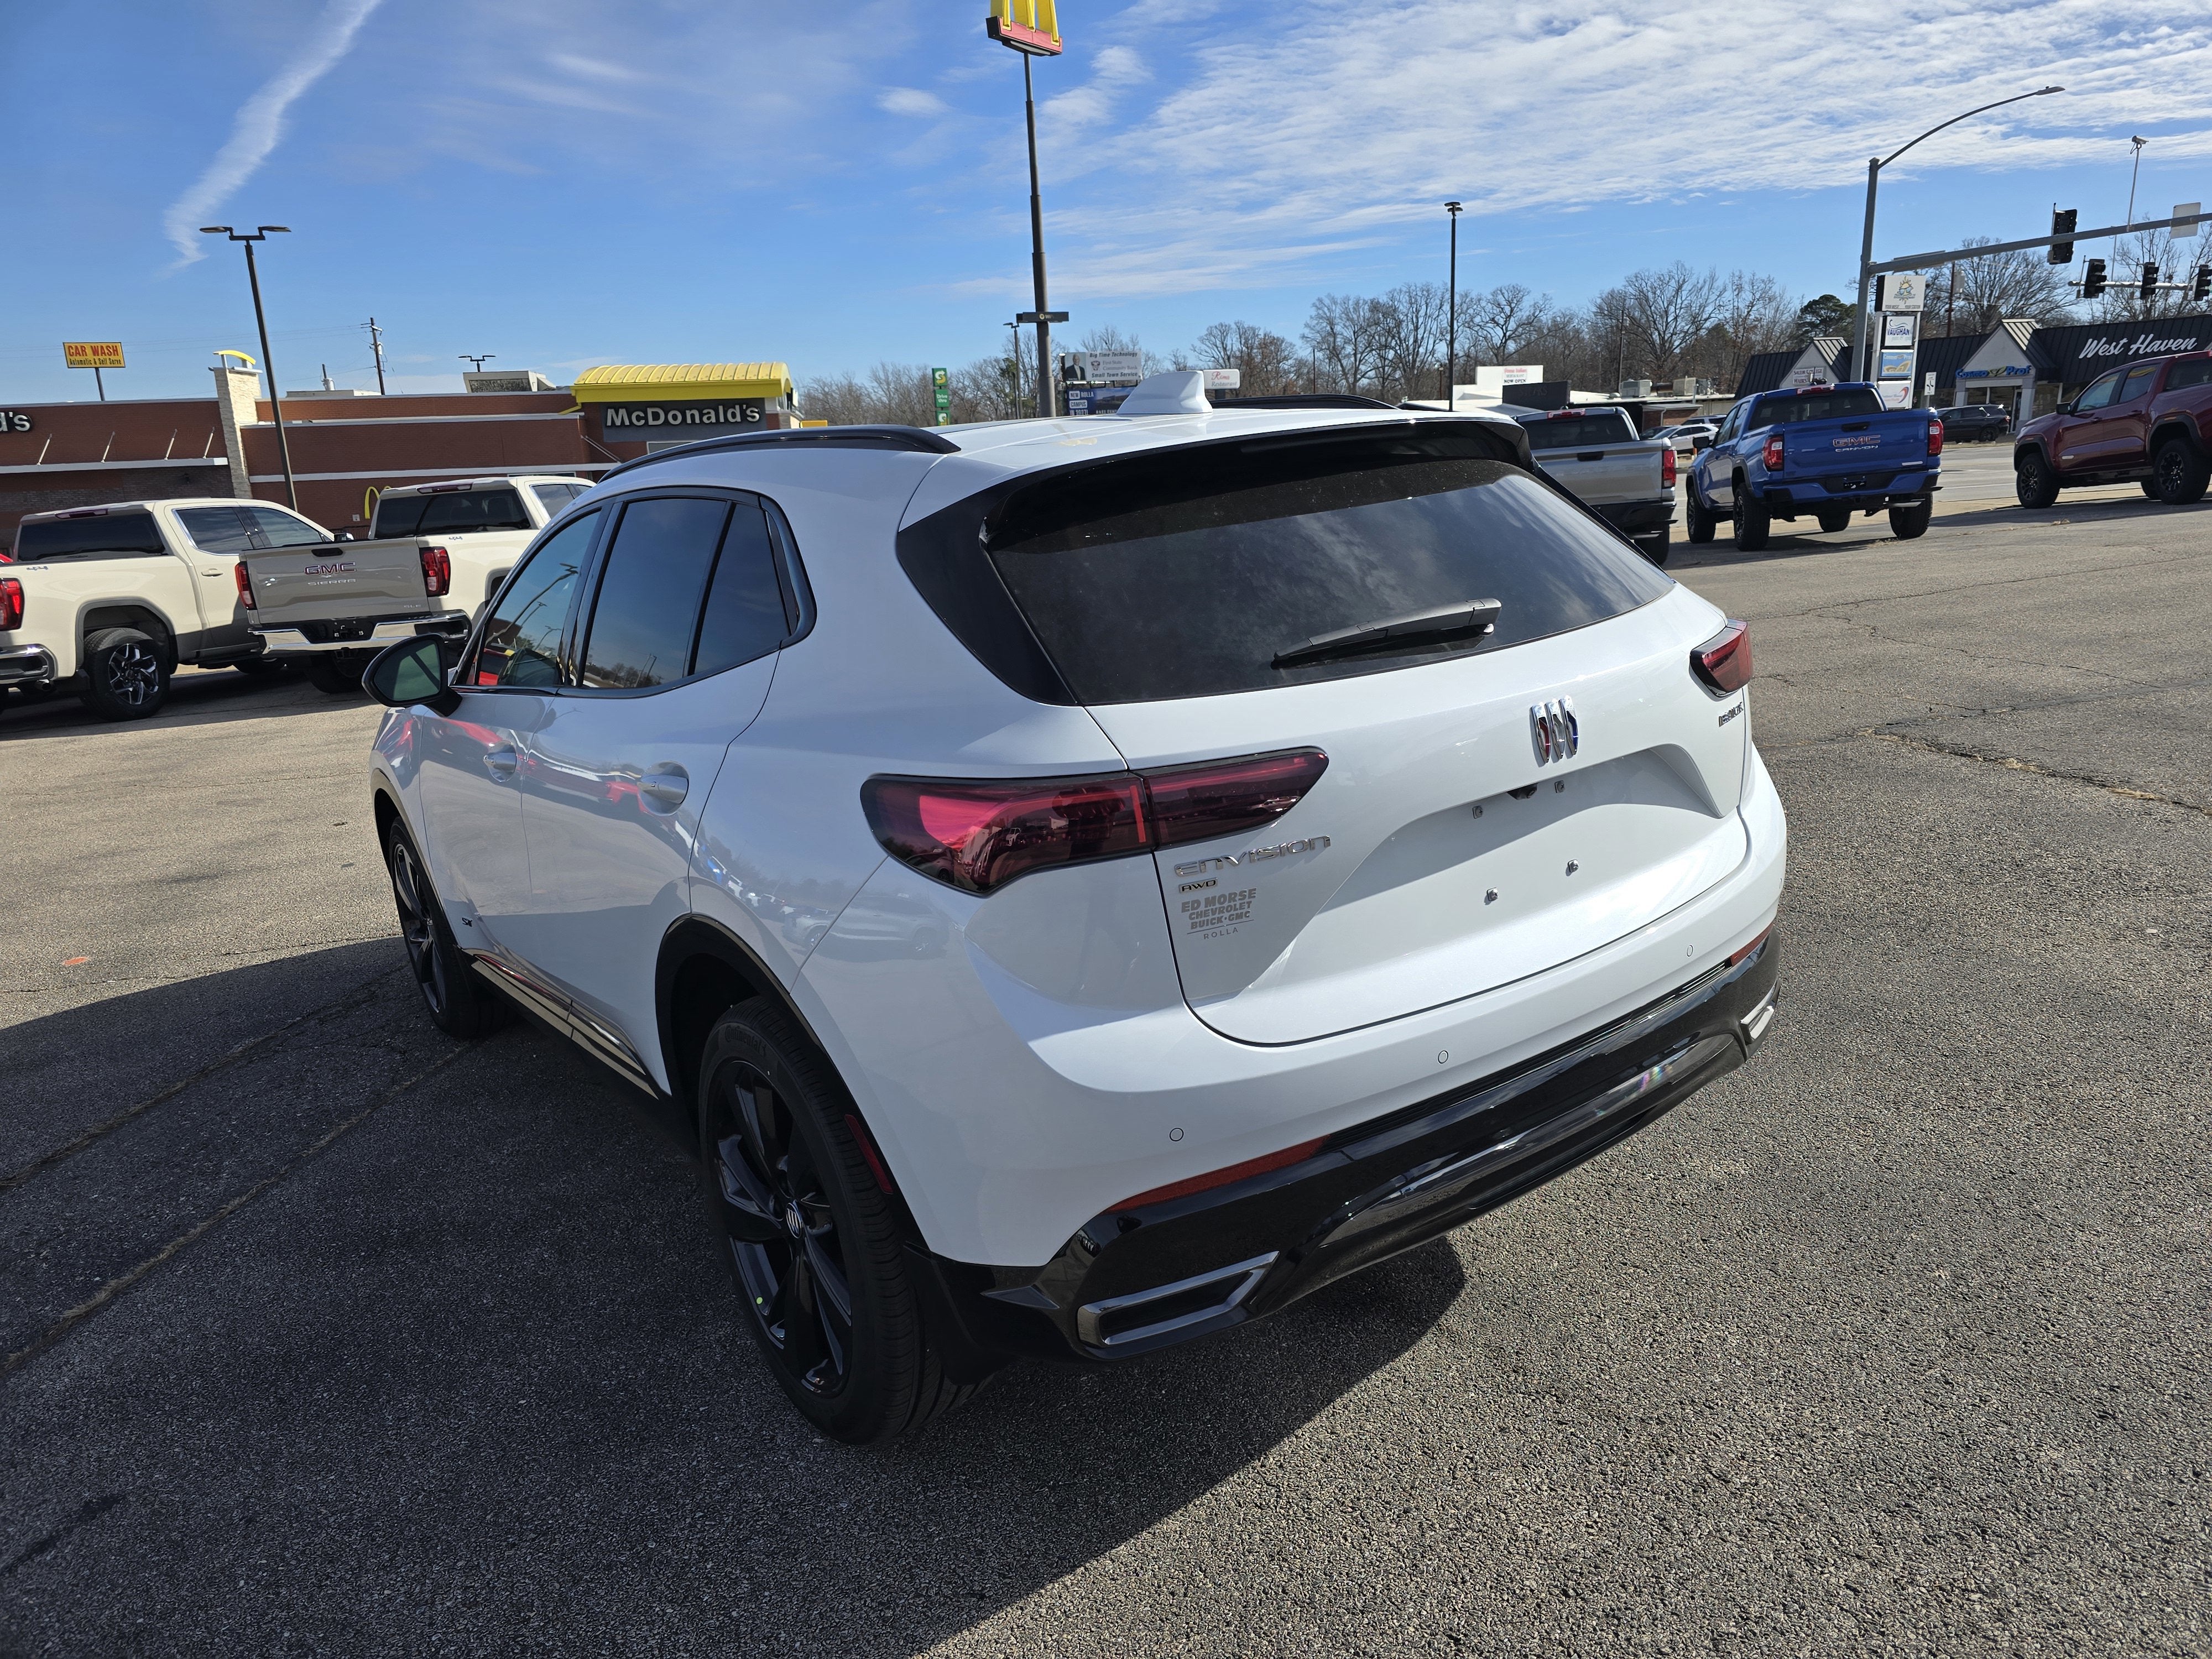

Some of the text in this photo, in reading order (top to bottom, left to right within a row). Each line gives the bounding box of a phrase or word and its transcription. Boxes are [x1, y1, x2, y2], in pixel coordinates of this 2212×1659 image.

[68, 345, 119, 357] CAR WASH
[2078, 333, 2198, 359] West Haven
[1955, 365, 2032, 379] Cosmo Prof
[606, 404, 760, 426] McDonald's
[1833, 435, 1881, 447] GMC
[305, 561, 357, 576] GMC
[1181, 880, 1216, 892] AWD
[1181, 888, 1257, 913] ED MORSE
[1188, 900, 1253, 921] CHEVROLET
[1203, 927, 1239, 940] ROLLA
